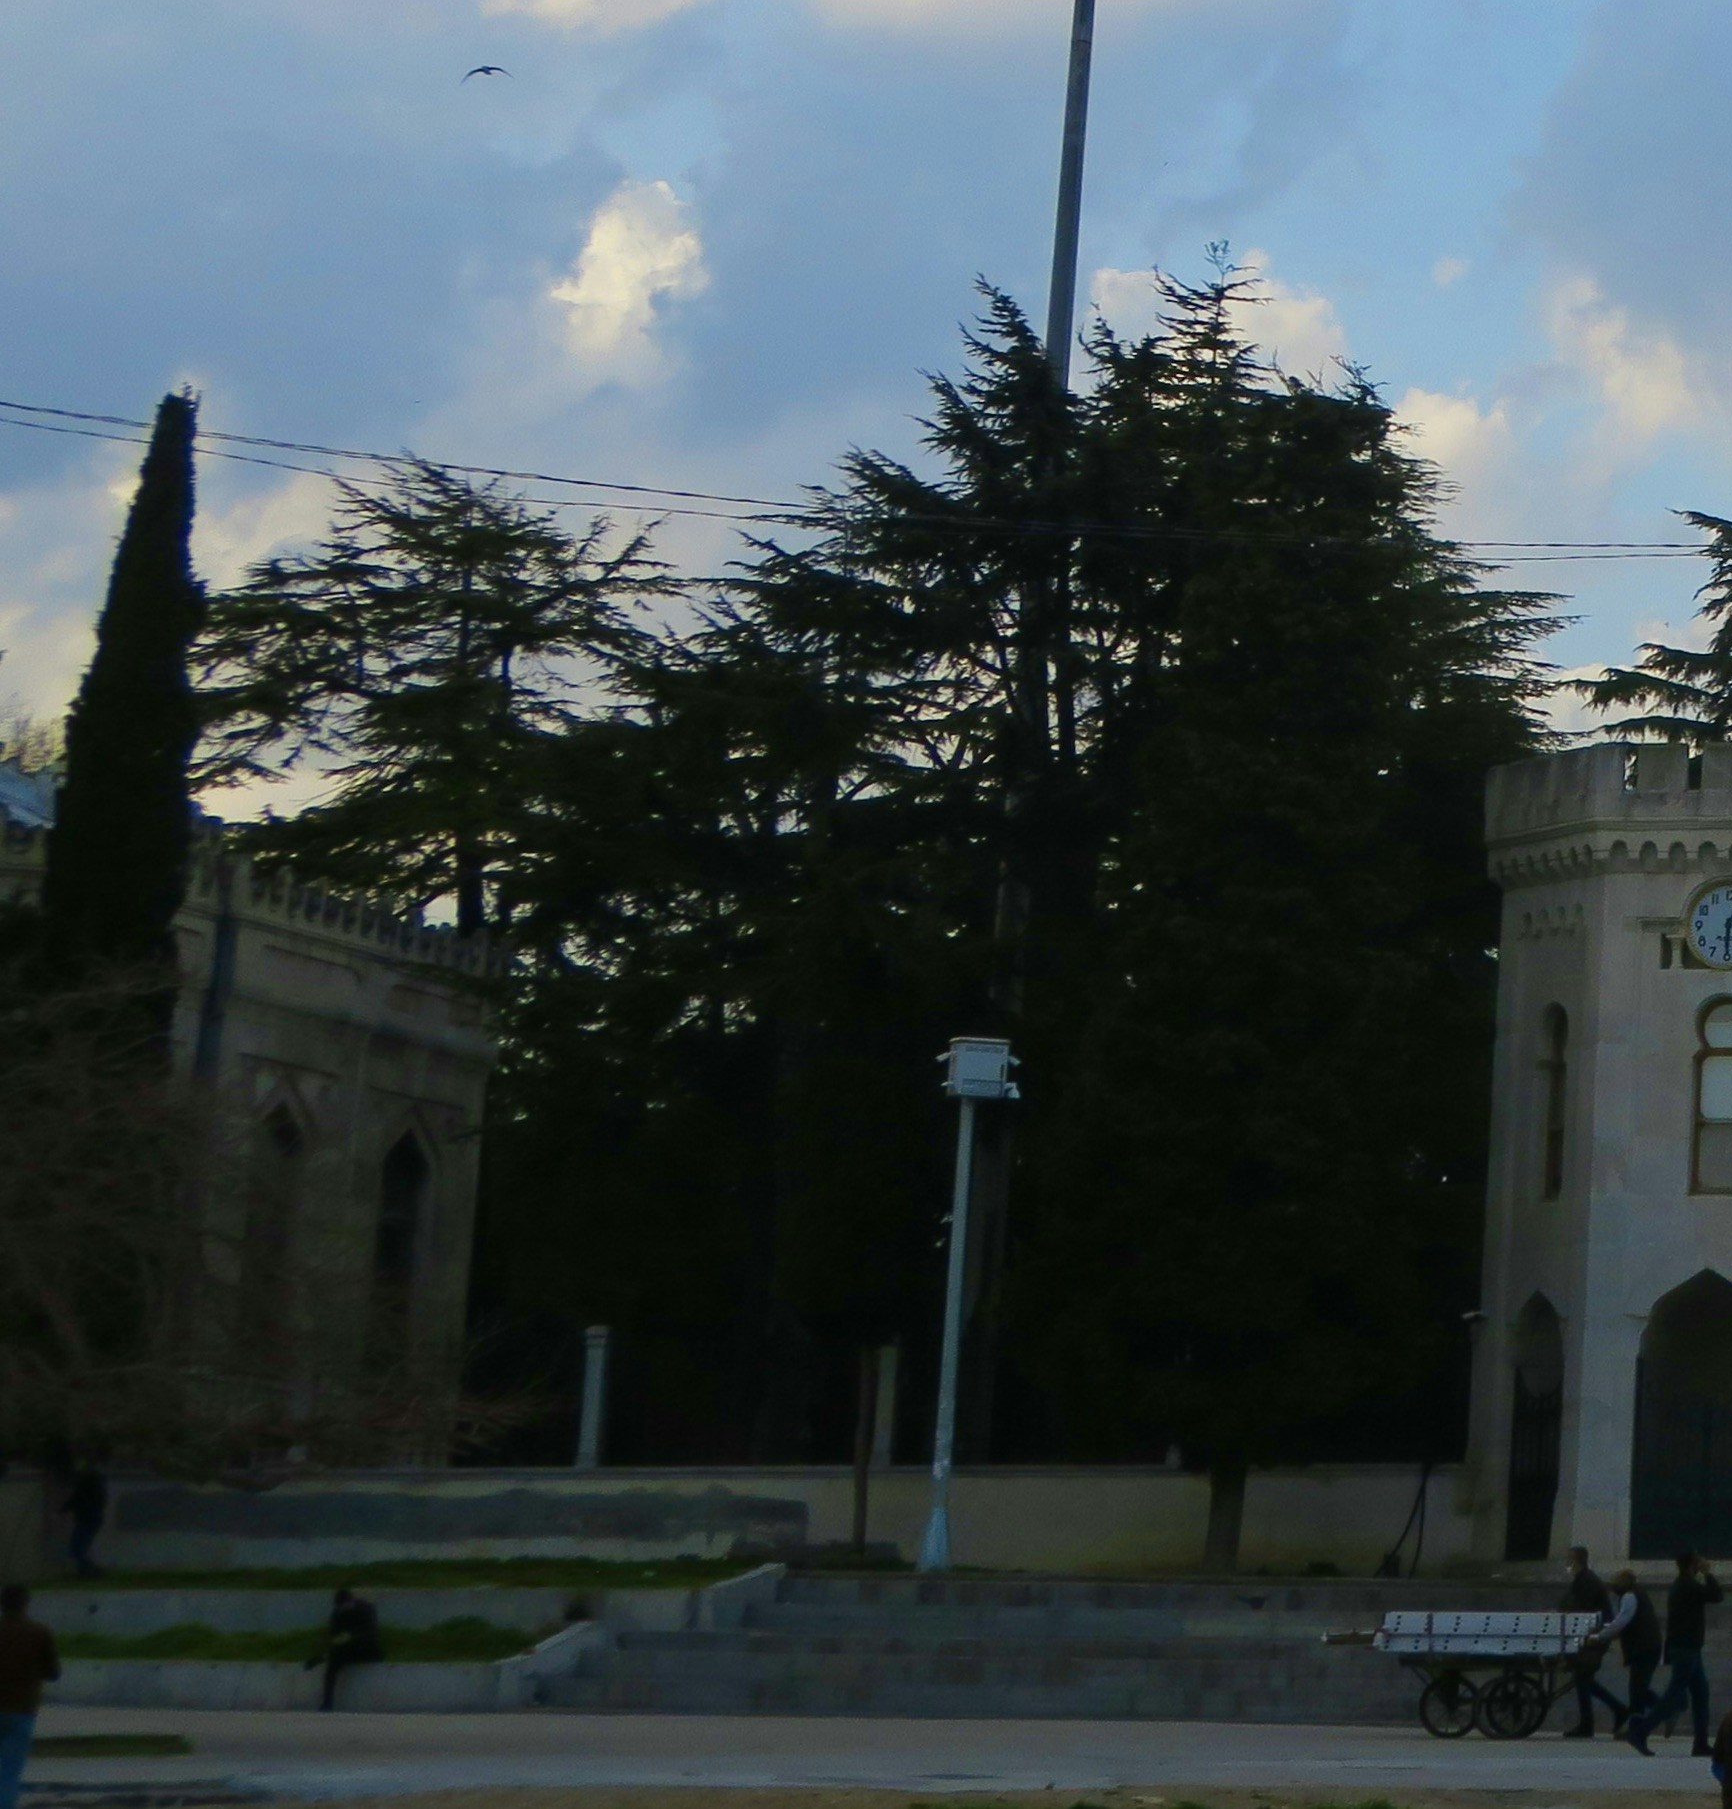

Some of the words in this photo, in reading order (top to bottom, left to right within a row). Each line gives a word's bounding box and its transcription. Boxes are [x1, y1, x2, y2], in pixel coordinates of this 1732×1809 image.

[1712, 893, 1719, 905] 11
[1699, 905, 1709, 916] 10
[1695, 920, 1703, 931] 9
[1698, 936, 1706, 947] 8
[1709, 946, 1716, 957] 7
